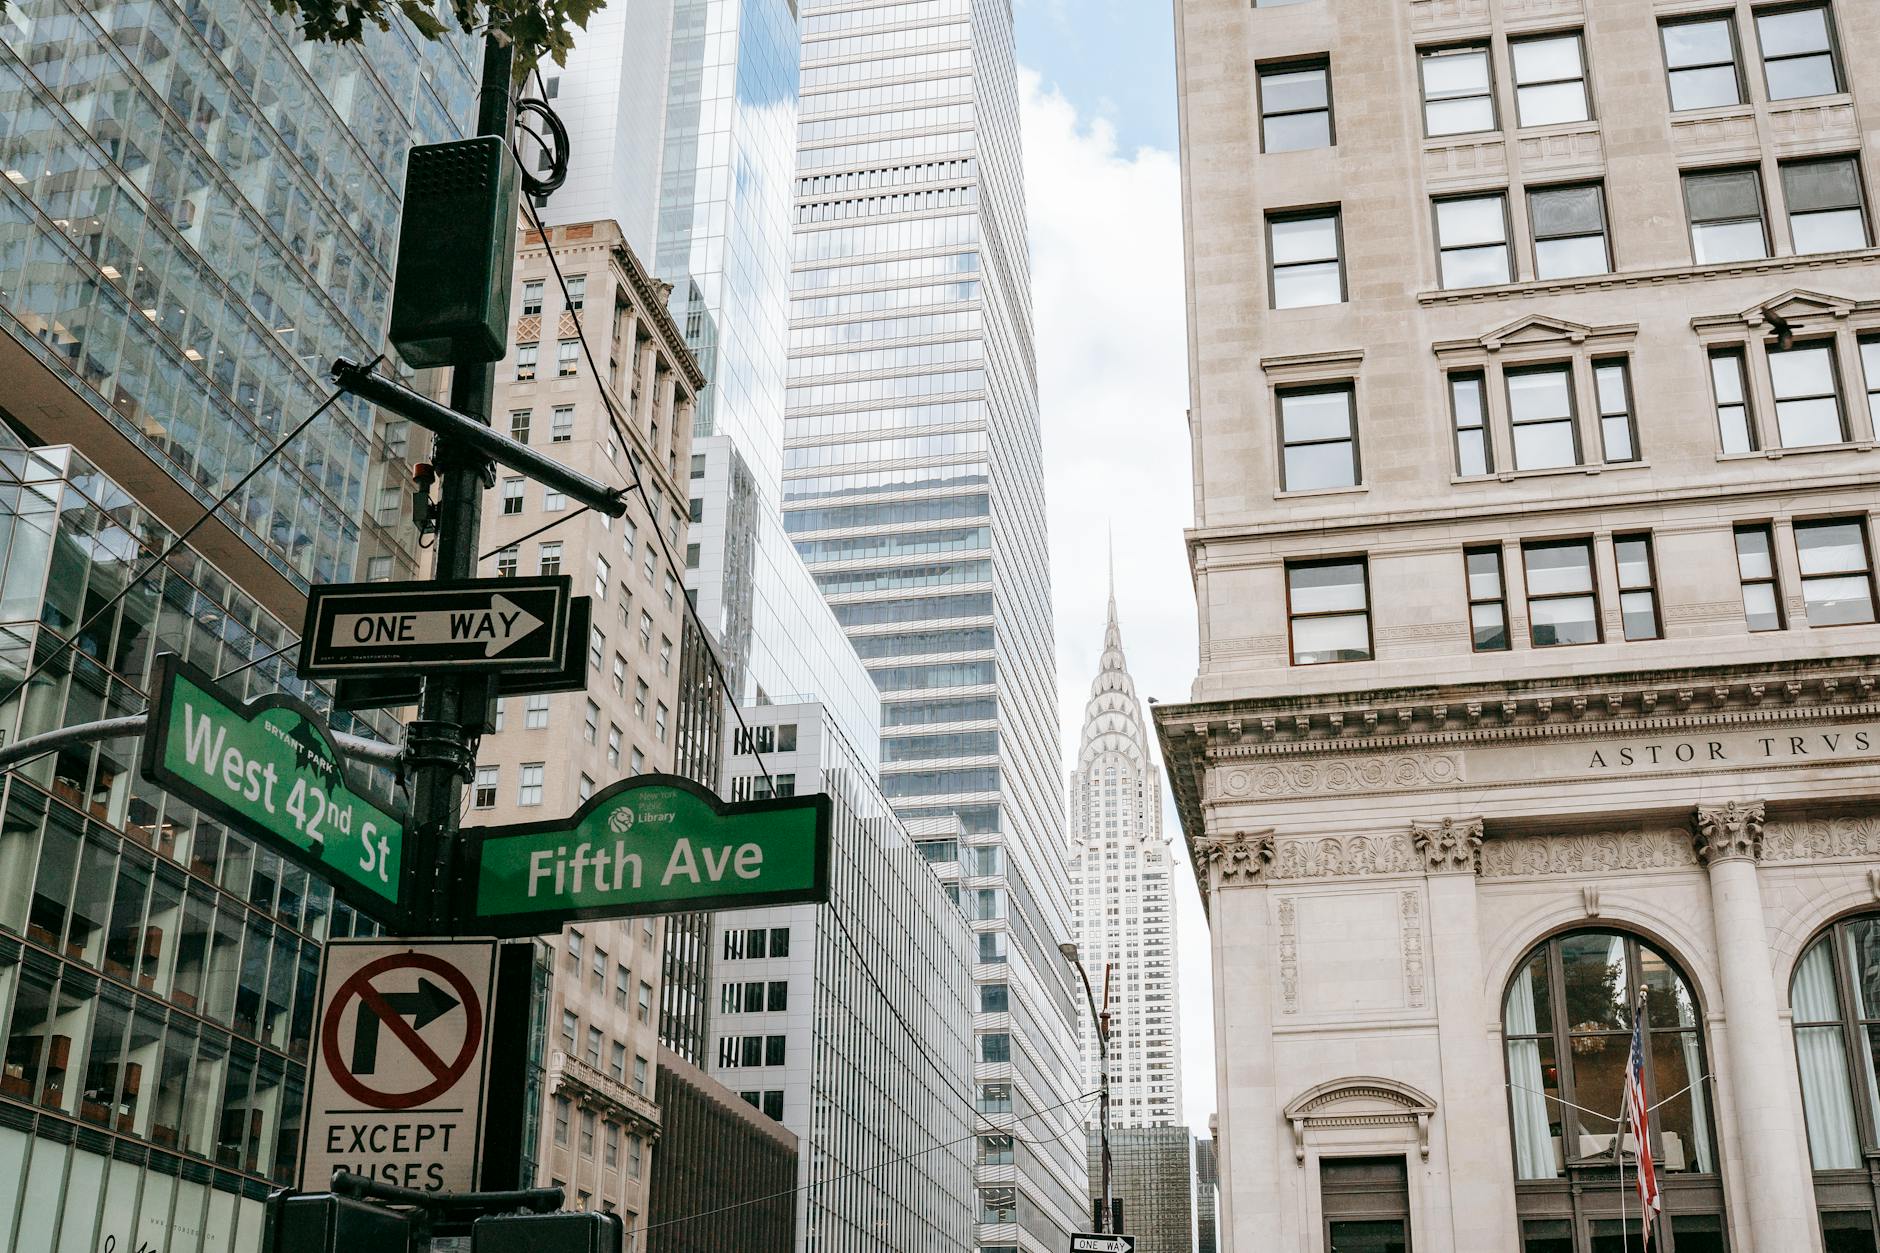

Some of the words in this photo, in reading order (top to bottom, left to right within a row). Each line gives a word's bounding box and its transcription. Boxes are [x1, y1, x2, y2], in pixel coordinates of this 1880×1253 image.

[353, 615, 416, 643] ONE
[450, 611, 521, 640] WAY
[264, 720, 305, 753] BRYANT
[307, 750, 333, 774] PARK
[1589, 741, 1727, 768] ASTOR
[184, 702, 278, 814] West
[286, 777, 352, 843] 42nd
[359, 821, 390, 883] St
[639, 791, 658, 800] New
[661, 790, 677, 799] York
[638, 812, 676, 823] Library
[527, 840, 643, 898] Fifth
[660, 837, 763, 887] Ave
[326, 1124, 456, 1153] EXCEPT
[1079, 1240, 1098, 1250] ONE
[1106, 1242, 1125, 1252] WAY
